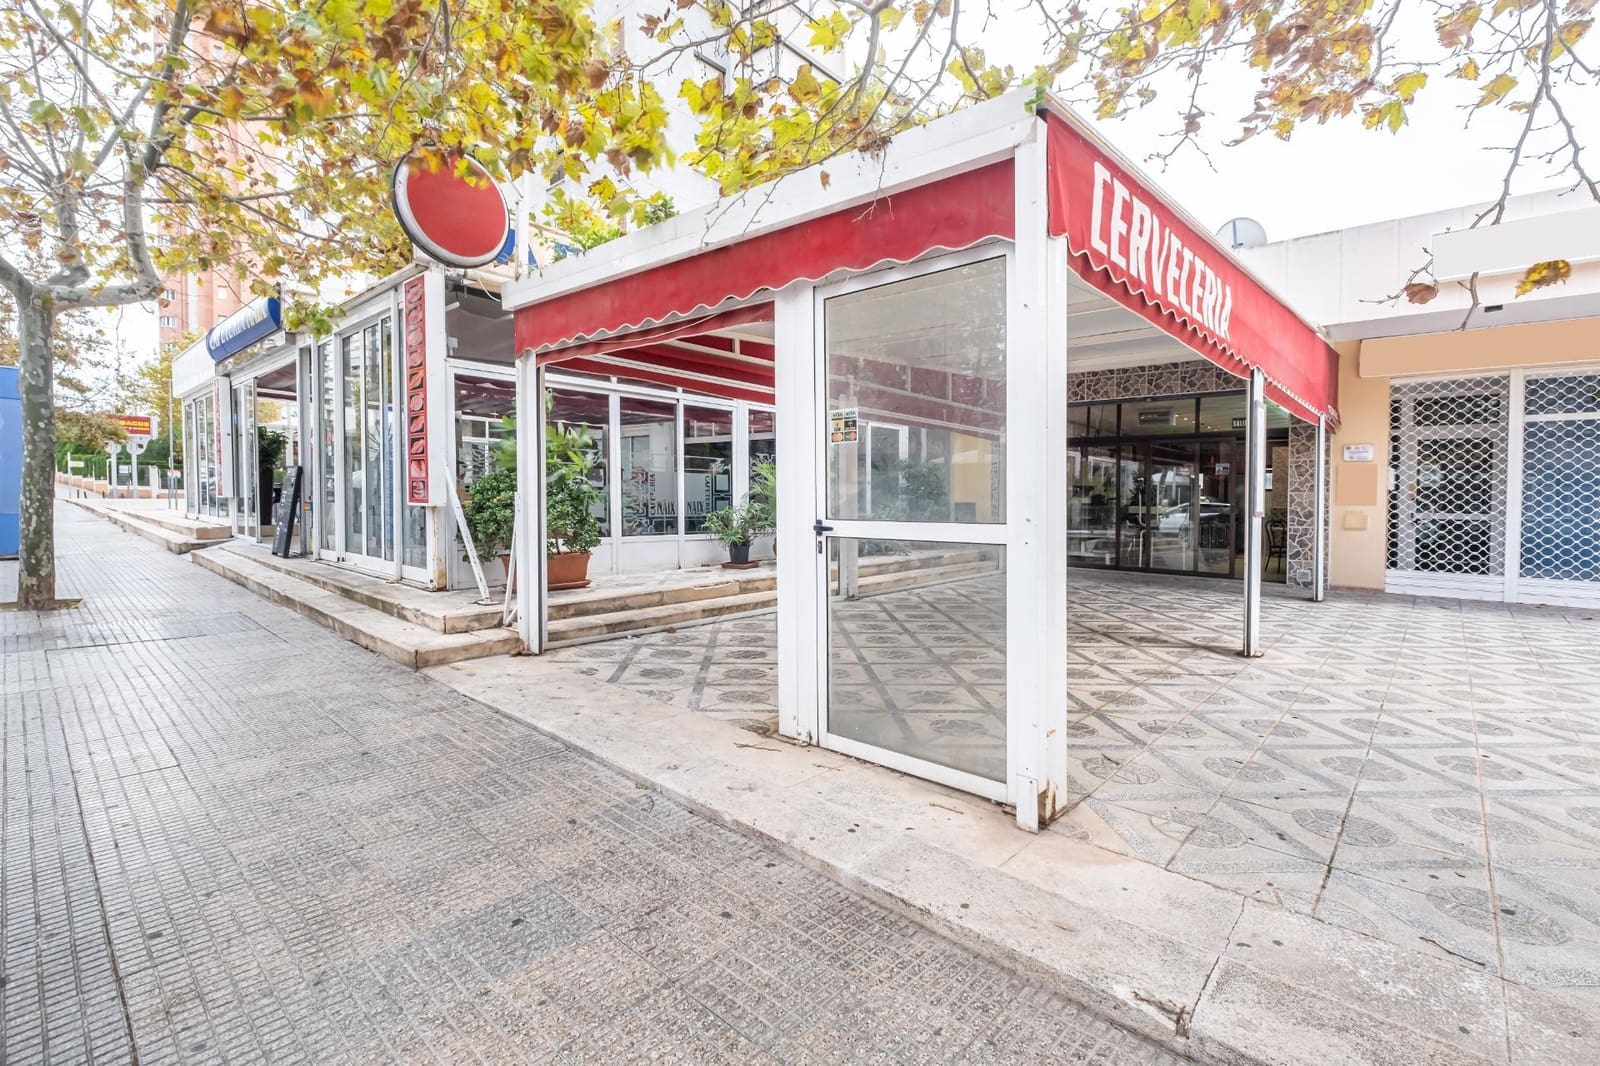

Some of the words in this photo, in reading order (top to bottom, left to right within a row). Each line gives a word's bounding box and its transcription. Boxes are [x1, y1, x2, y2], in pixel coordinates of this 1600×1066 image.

[1091, 160, 1233, 342] CERVECERIA
[656, 501, 675, 515] NAIX
[687, 501, 704, 513] NAIX
